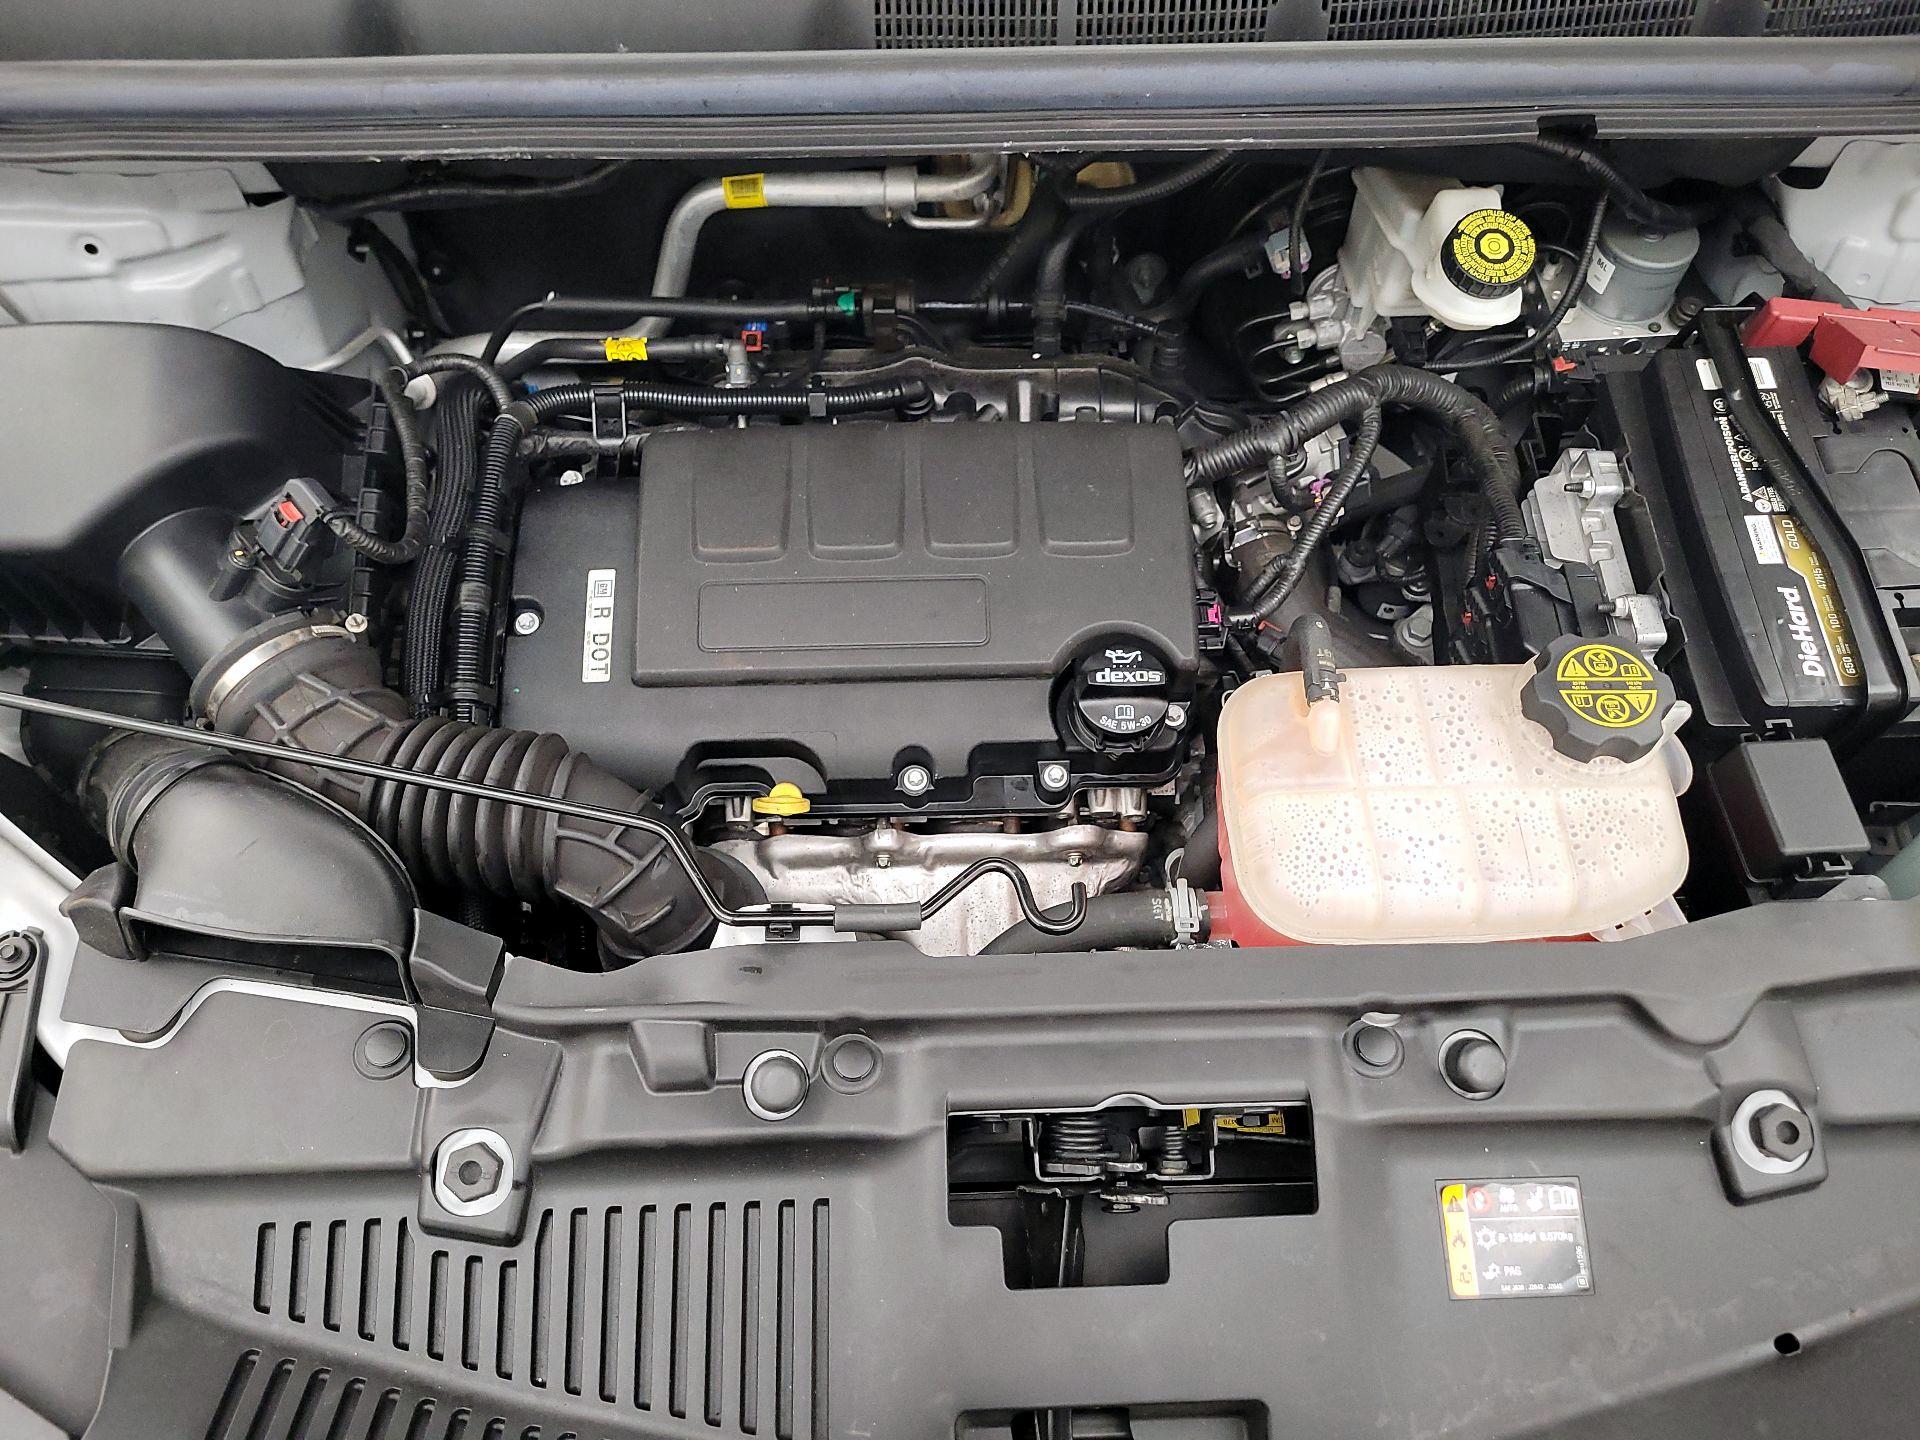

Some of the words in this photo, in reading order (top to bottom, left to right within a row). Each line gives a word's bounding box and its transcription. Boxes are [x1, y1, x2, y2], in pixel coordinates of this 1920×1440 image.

[1486, 209, 1505, 217] FILLER
[1504, 212, 1517, 222] CAP
[1718, 416, 1752, 498] DANGER/POISON
[1781, 519, 1800, 550] GOLD
[1812, 568, 1826, 590] 47H5
[594, 606, 611, 619] R
[1827, 613, 1841, 629] 100
[1777, 586, 1826, 677] DieHard
[591, 633, 610, 675] DOT
[1842, 656, 1856, 674] 650
[1095, 668, 1163, 683] dexos
[1099, 715, 1118, 729] SAE
[1121, 715, 1152, 730] 5W-30
